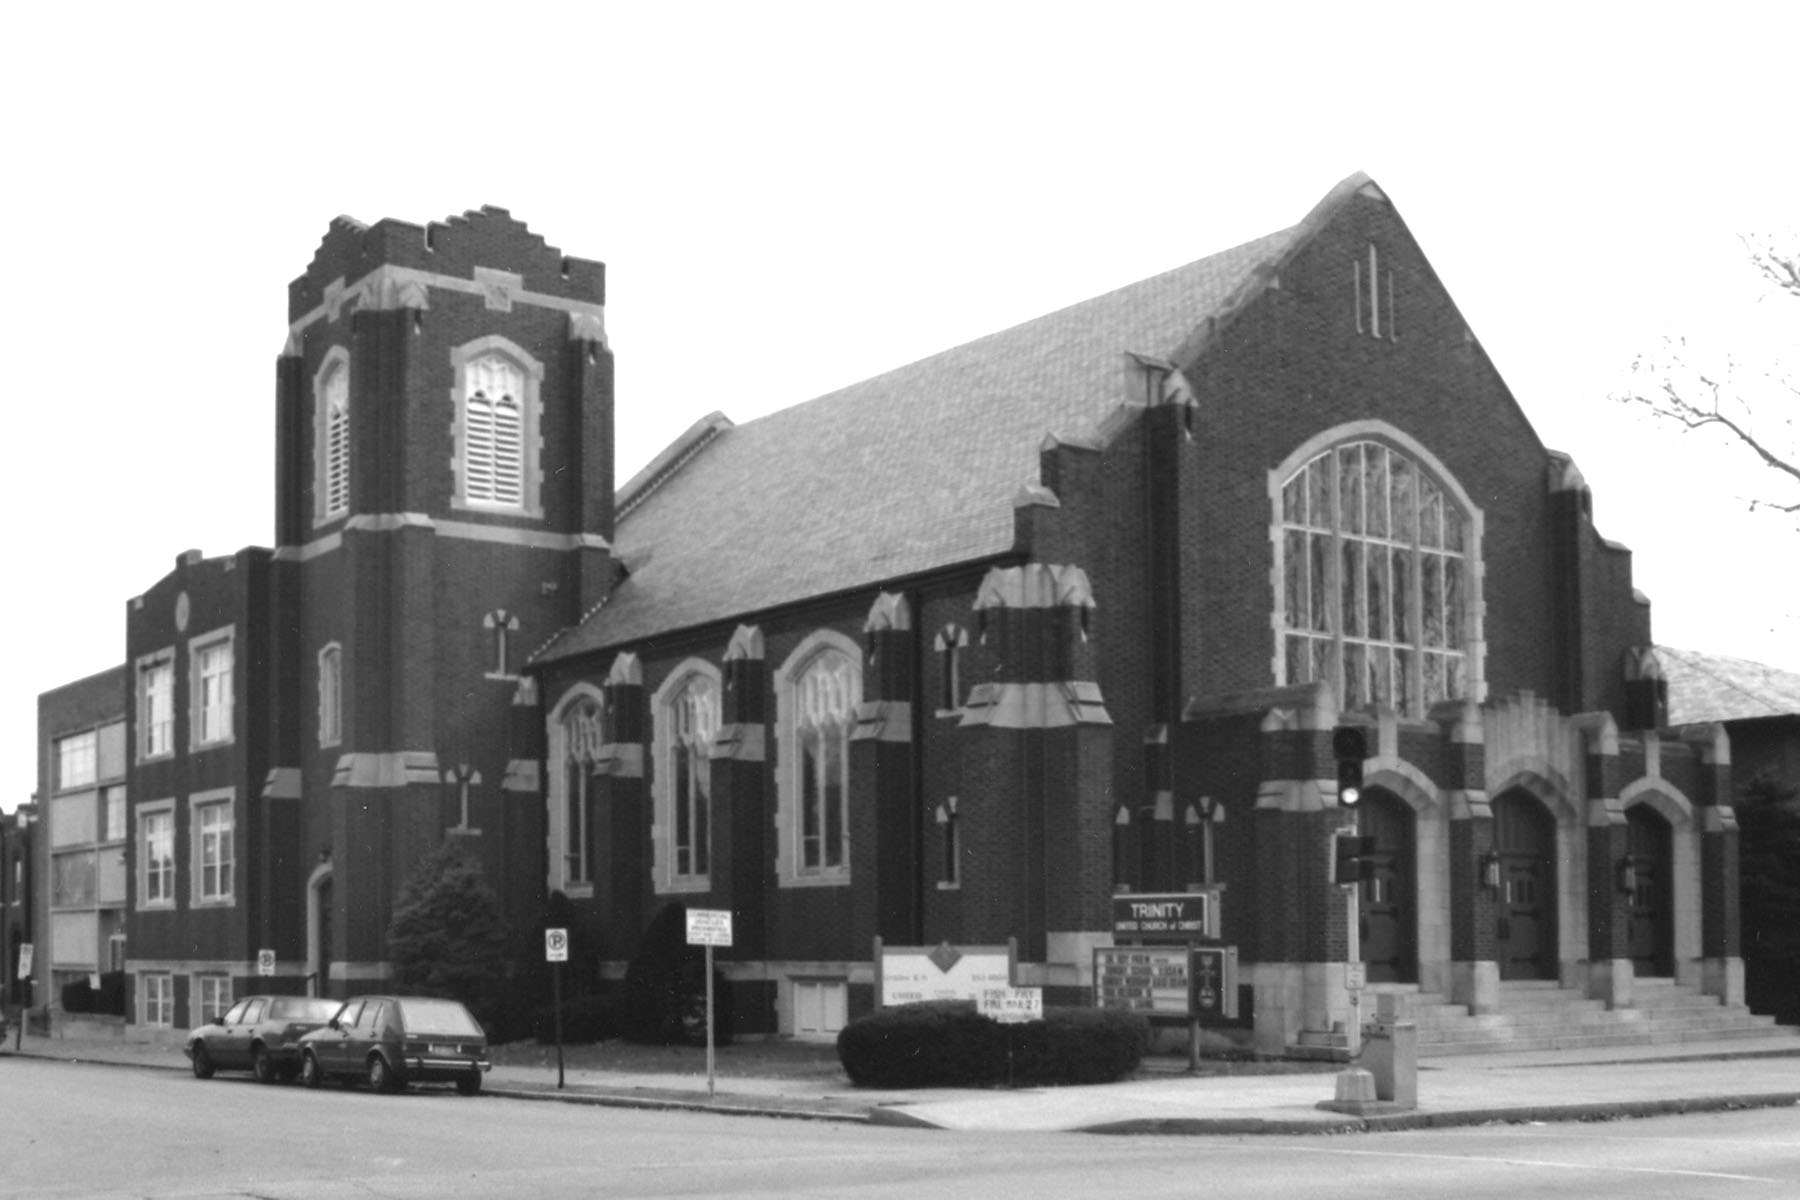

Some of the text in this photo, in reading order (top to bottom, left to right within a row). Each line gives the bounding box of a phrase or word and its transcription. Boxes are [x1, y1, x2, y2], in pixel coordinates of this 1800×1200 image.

[1130, 903, 1184, 918] TRINITY
[1115, 921, 1138, 930] UNITED
[1140, 921, 1167, 930] CHURCH
[1178, 920, 1201, 930] CHRIST
